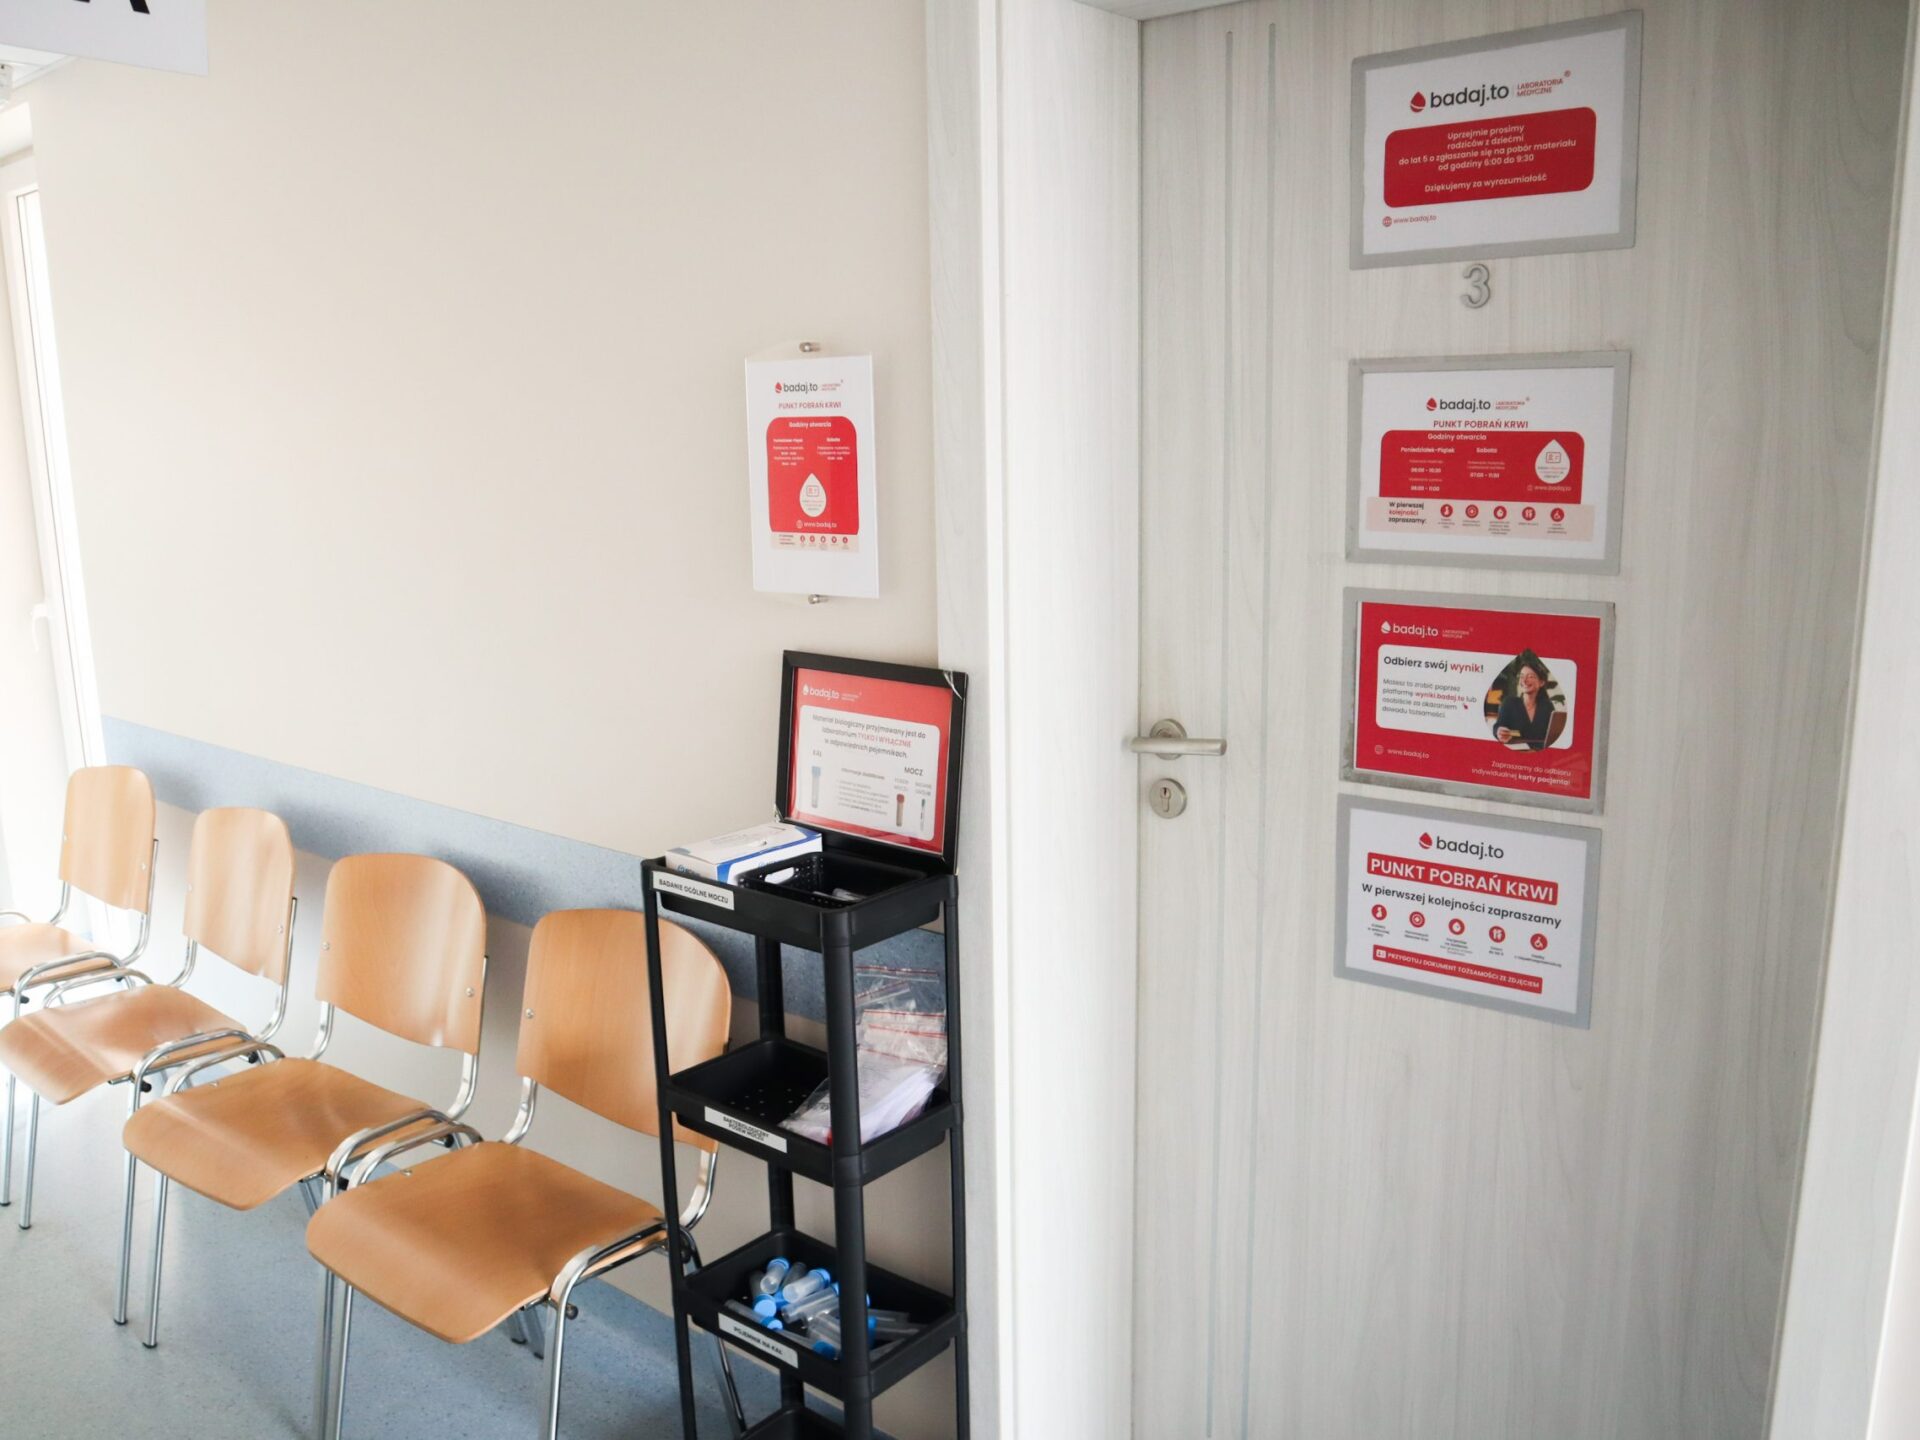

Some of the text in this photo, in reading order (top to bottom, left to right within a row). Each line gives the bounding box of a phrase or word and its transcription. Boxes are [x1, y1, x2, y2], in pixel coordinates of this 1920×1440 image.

[1517, 78, 1563, 90] LABORATORIA
[1430, 84, 1509, 108] badaj.to
[1517, 87, 1553, 97] MEDYCZNE
[1448, 124, 1524, 140] Uprzejmie prosimy
[1448, 138, 1484, 150] rodziców
[1491, 134, 1524, 145] dziećmi
[1398, 157, 1408, 165] do
[1410, 155, 1422, 164] lat
[1436, 150, 1478, 164] zgłaszanie
[1480, 148, 1492, 158] się
[1506, 144, 1532, 156] pobór
[1534, 138, 1576, 150] materiału
[1438, 163, 1448, 171] od
[1450, 160, 1482, 172] godziny
[1484, 157, 1502, 166] 6:00
[1504, 156, 1514, 164] do
[1424, 174, 1548, 193] Dziękujemy za wyrozumiałość
[1393, 214, 1437, 223] www.badaj.to
[1460, 263, 1490, 309] 3
[784, 382, 818, 394] badaj.to
[1440, 398, 1490, 413] badaj.to
[1433, 420, 1462, 428] PUNKT
[1464, 418, 1502, 428] POBRAŃ
[1428, 434, 1454, 442] Godziny
[1396, 502, 1424, 510] pierwszej
[1393, 624, 1438, 638] badaj.to
[1384, 656, 1484, 674] Odbierz swój wynik!
[810, 688, 840, 700] badaj.to
[1382, 688, 1414, 697] platformę
[1415, 692, 1464, 702] wyniki.badaj.to
[1434, 684, 1461, 692] poprzez
[1382, 706, 1408, 714] dowodu
[1422, 702, 1457, 710] okazaniem
[866, 723, 904, 736] przyjmowany
[905, 730, 917, 738] jest
[1388, 748, 1430, 759] www.badaj.to
[1518, 774, 1536, 782] karty
[1544, 768, 1571, 776] odbioru
[1436, 836, 1504, 860] badaj.to
[1370, 858, 1554, 902] PUNKT POBRAŃ KRWI
[658, 878, 729, 904] BADANIE OGÓLNE MOCZU
[1362, 883, 1562, 928] W pierwszej kolejności zapraszamy
[1388, 952, 1422, 964] PRZYGOTUJ
[1423, 960, 1456, 972] DOKUMENT
[1500, 974, 1506, 982] ZE
[1507, 976, 1540, 988] ZDJĘCIEM
